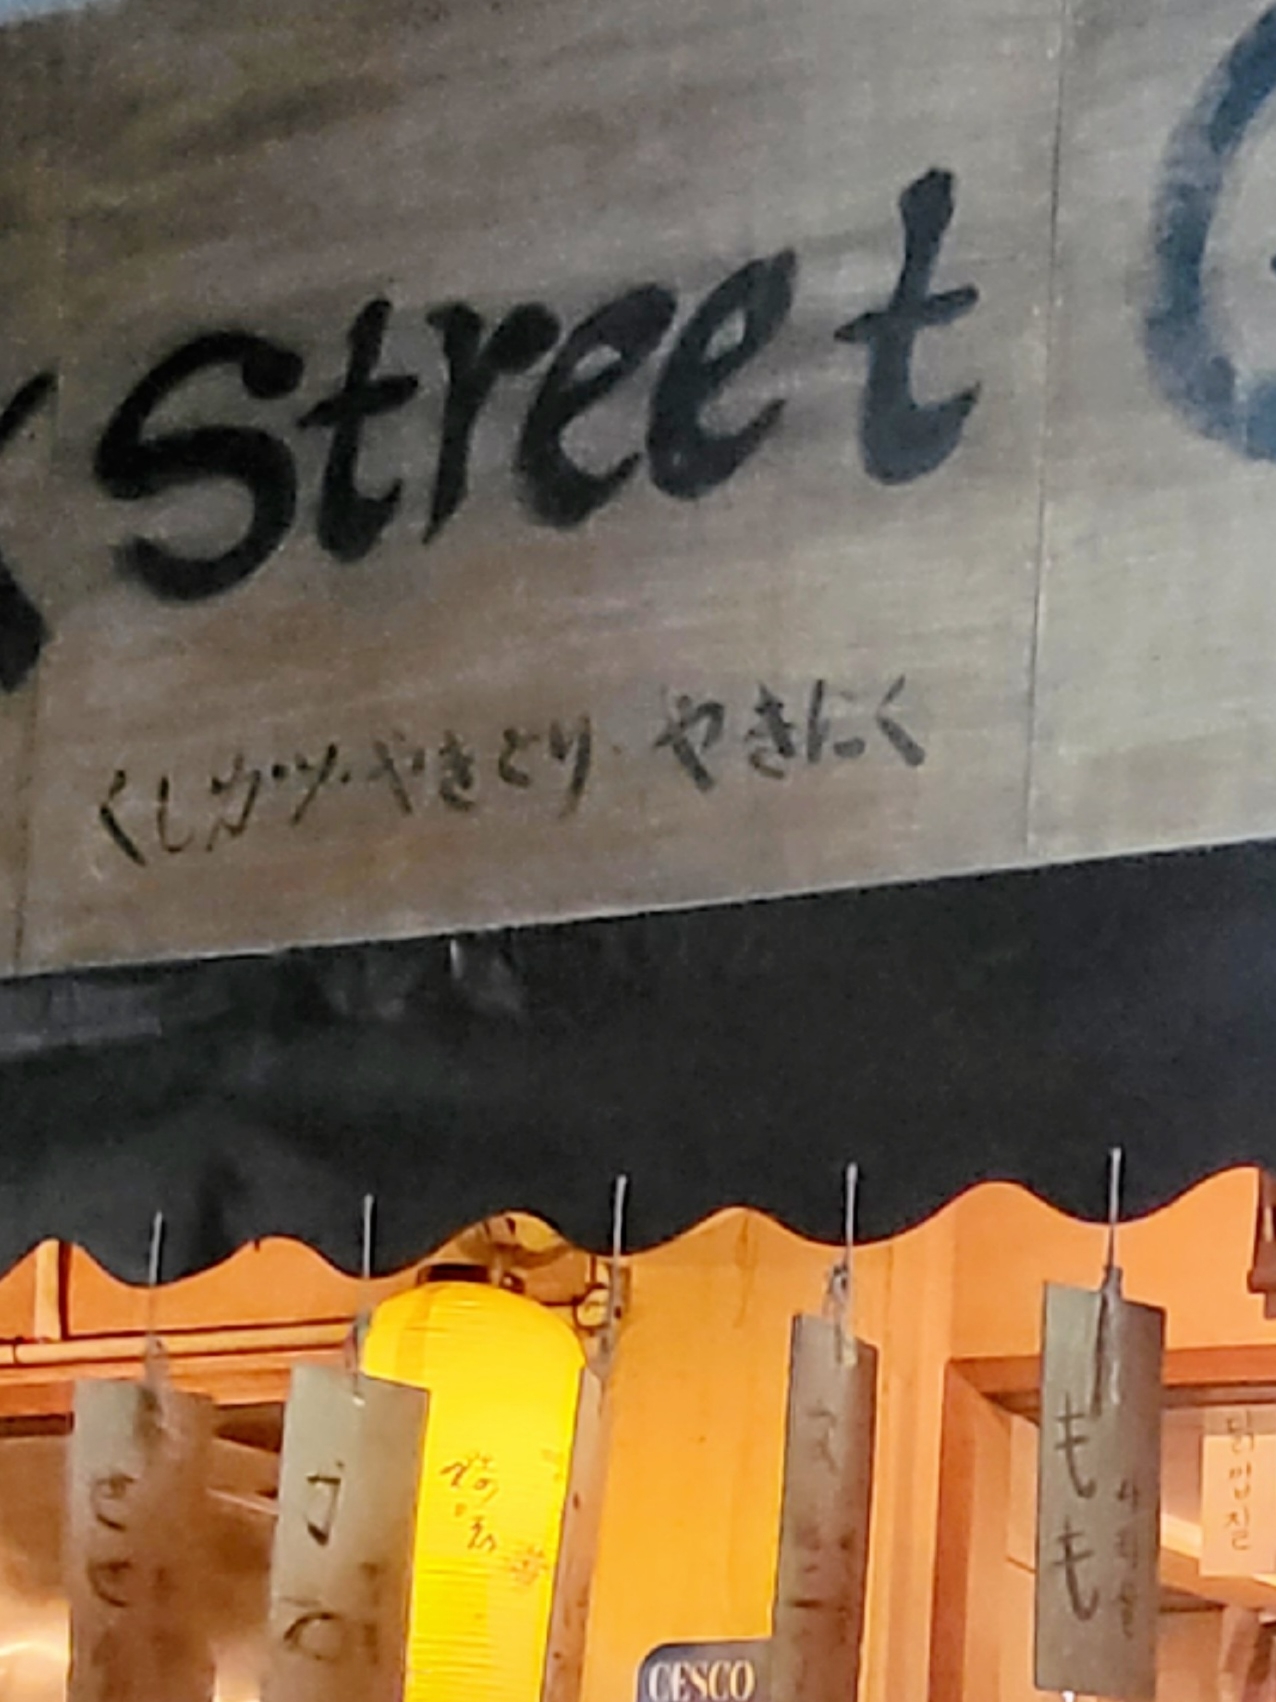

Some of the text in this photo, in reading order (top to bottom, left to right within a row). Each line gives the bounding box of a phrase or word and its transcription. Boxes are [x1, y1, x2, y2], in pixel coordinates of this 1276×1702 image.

[92, 166, 980, 603] Street
[1053, 1392, 1098, 1623] もも
[648, 1659, 756, 1702] CESCO
